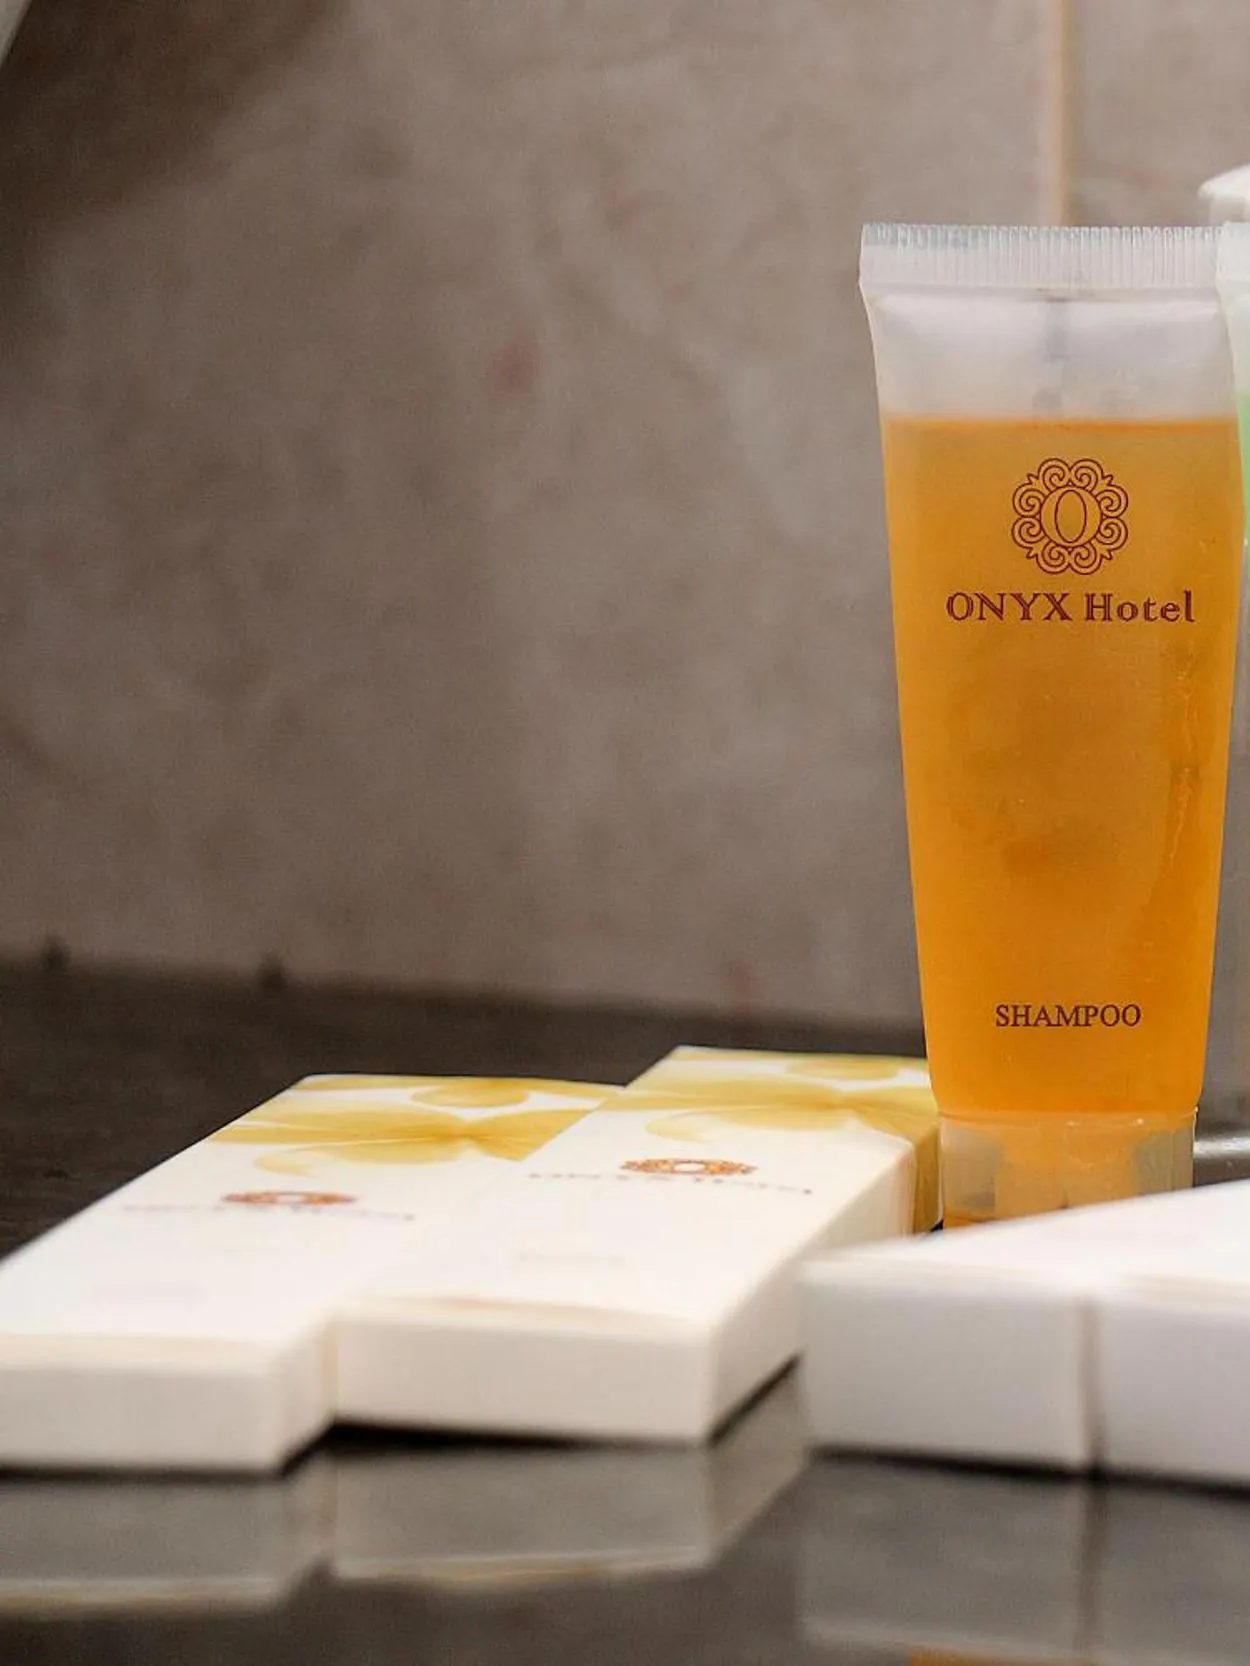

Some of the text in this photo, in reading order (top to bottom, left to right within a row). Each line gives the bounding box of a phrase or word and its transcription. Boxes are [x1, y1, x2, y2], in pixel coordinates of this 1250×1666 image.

[946, 590, 1195, 623] ONYX Hotel
[995, 1004, 1142, 1029] SHAMPOO
